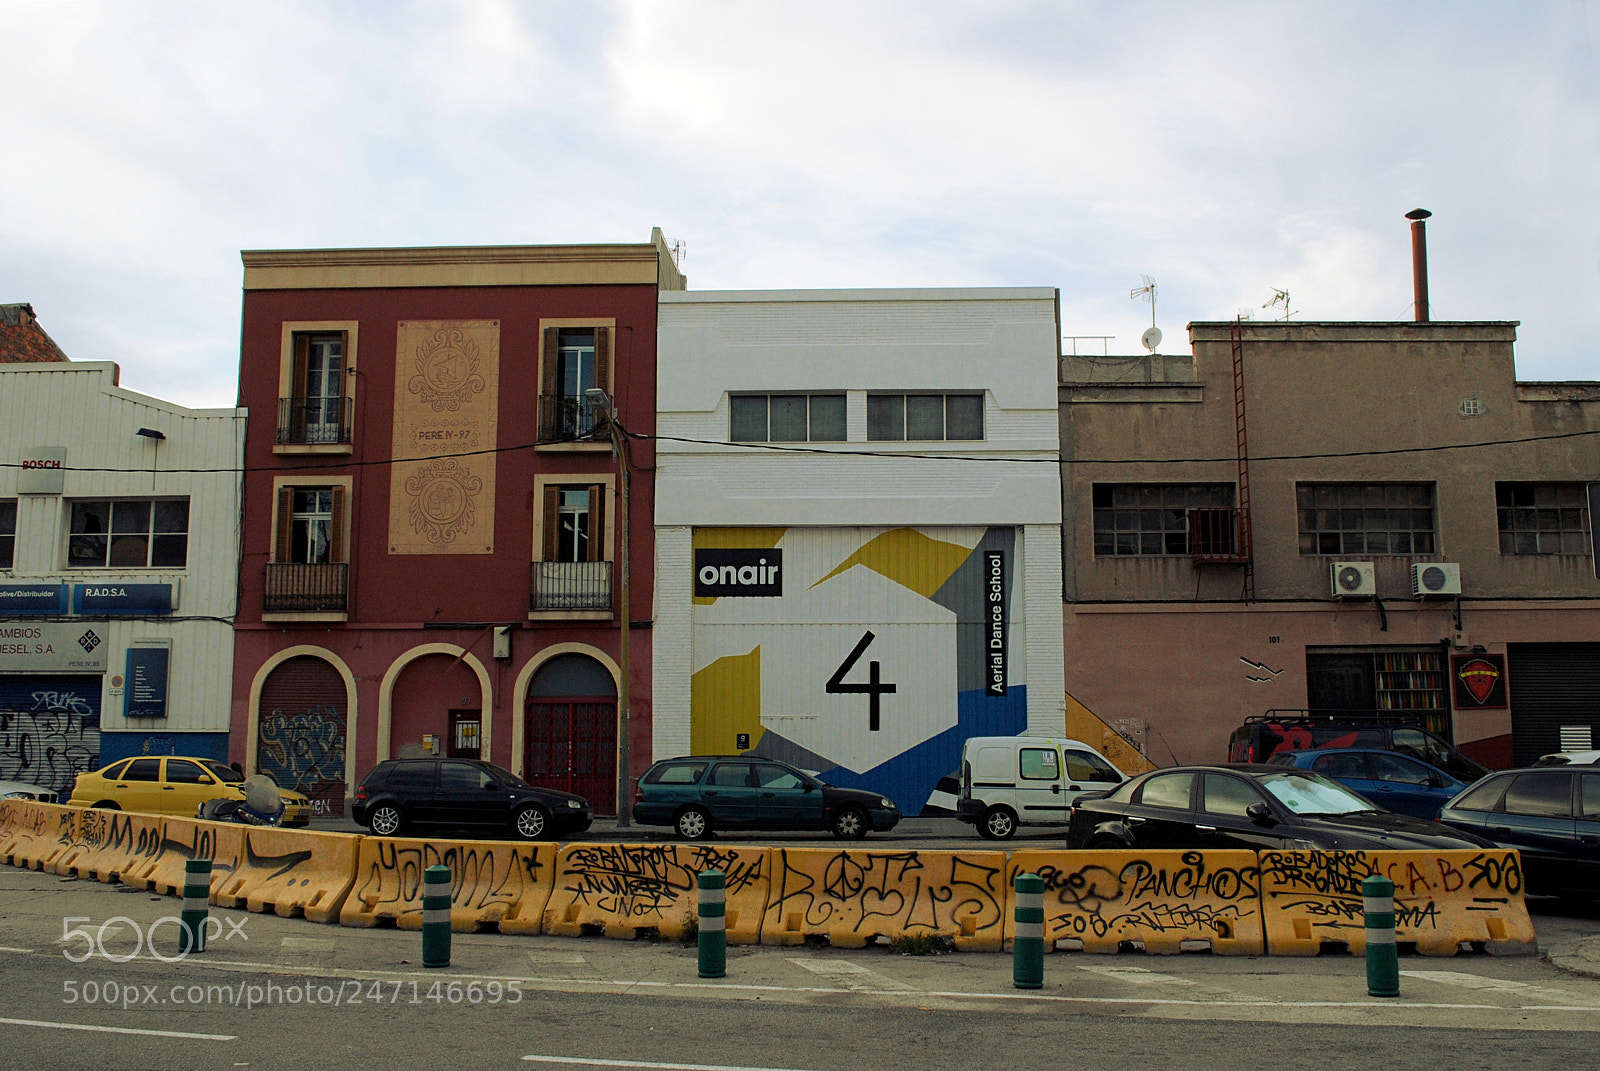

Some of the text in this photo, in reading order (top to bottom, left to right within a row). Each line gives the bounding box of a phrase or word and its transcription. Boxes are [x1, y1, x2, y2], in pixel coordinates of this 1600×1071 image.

[419, 430, 444, 440] PERE
[22, 460, 61, 470] BOSCH
[699, 558, 779, 585] onair
[85, 588, 128, 597] R.A.D.S.A.
[989, 555, 1003, 693] Aerial Dance School
[35, 644, 56, 654] S.A.
[826, 630, 896, 731] 4
